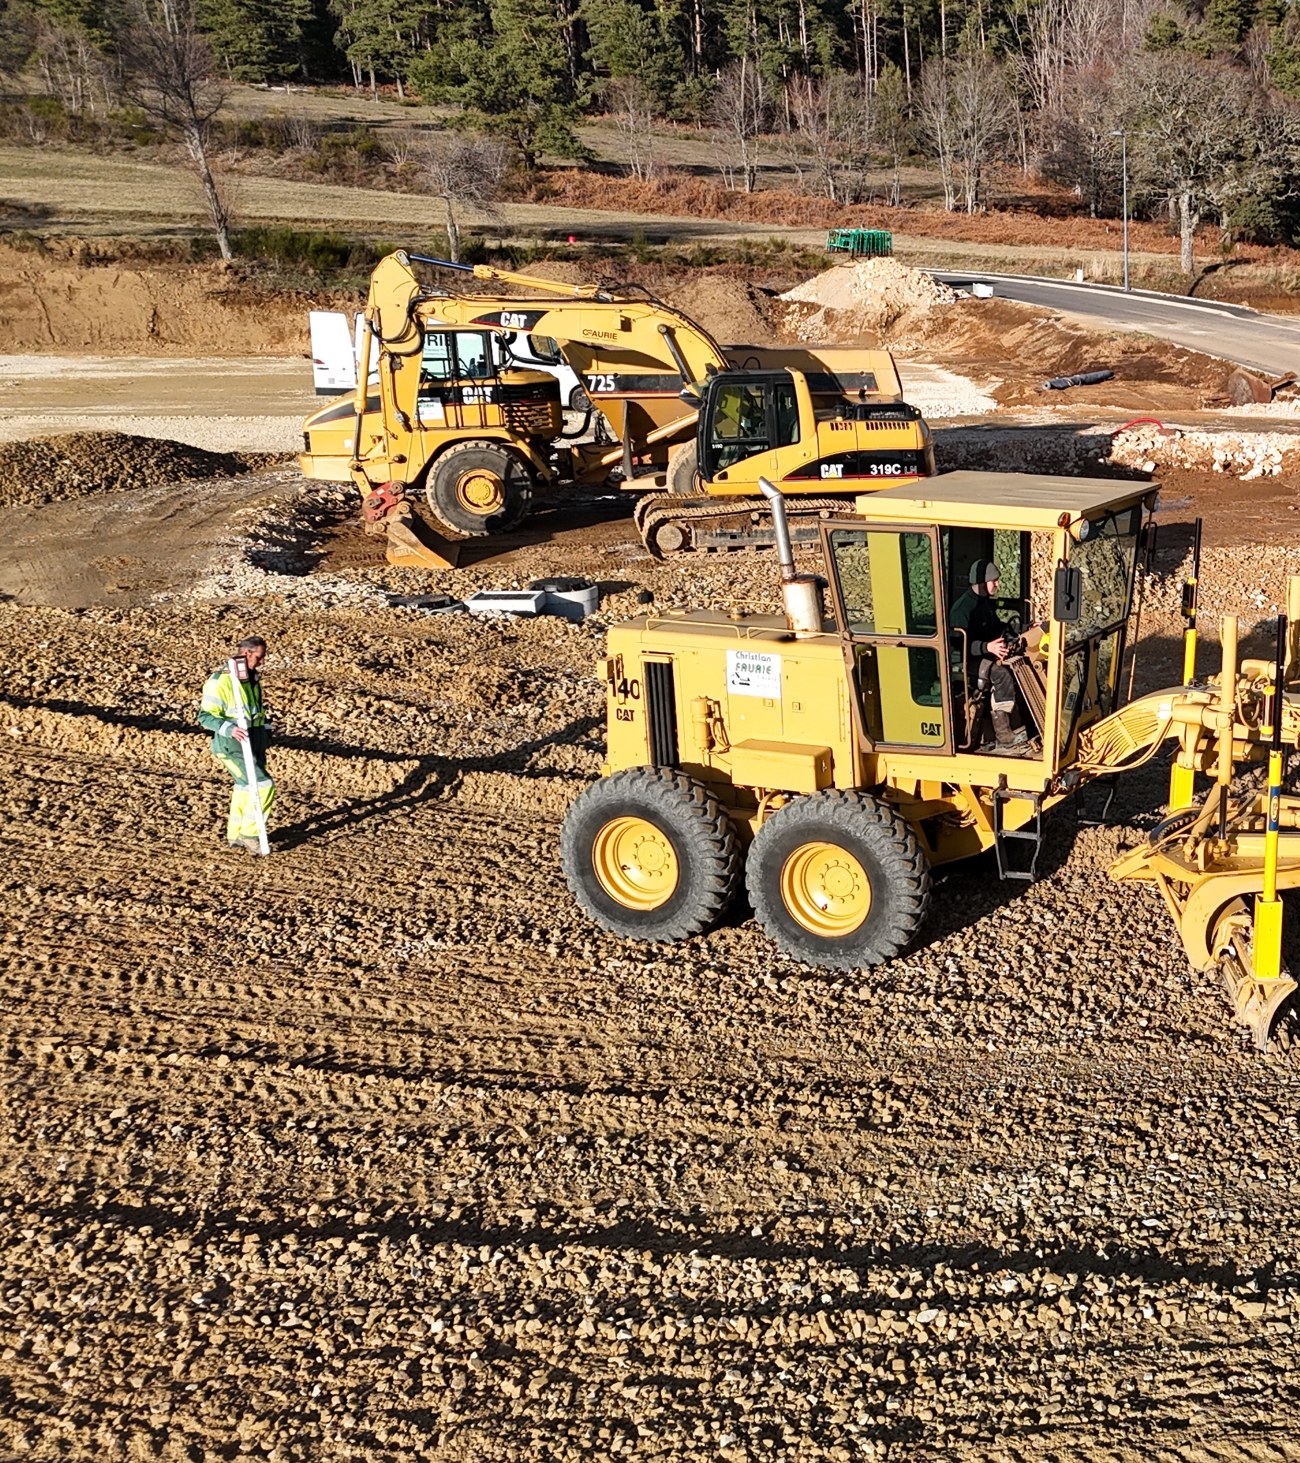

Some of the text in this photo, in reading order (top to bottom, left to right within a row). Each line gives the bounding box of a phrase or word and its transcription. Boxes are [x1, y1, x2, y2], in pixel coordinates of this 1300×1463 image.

[500, 311, 527, 329] CAT
[587, 375, 616, 392] 725
[462, 386, 493, 405] CAT
[820, 463, 844, 479] CAT
[870, 463, 902, 476] 319C
[735, 662, 772, 675] FAURIE
[608, 678, 640, 700] 140
[616, 708, 636, 722] CAT
[920, 722, 942, 737] CAT
